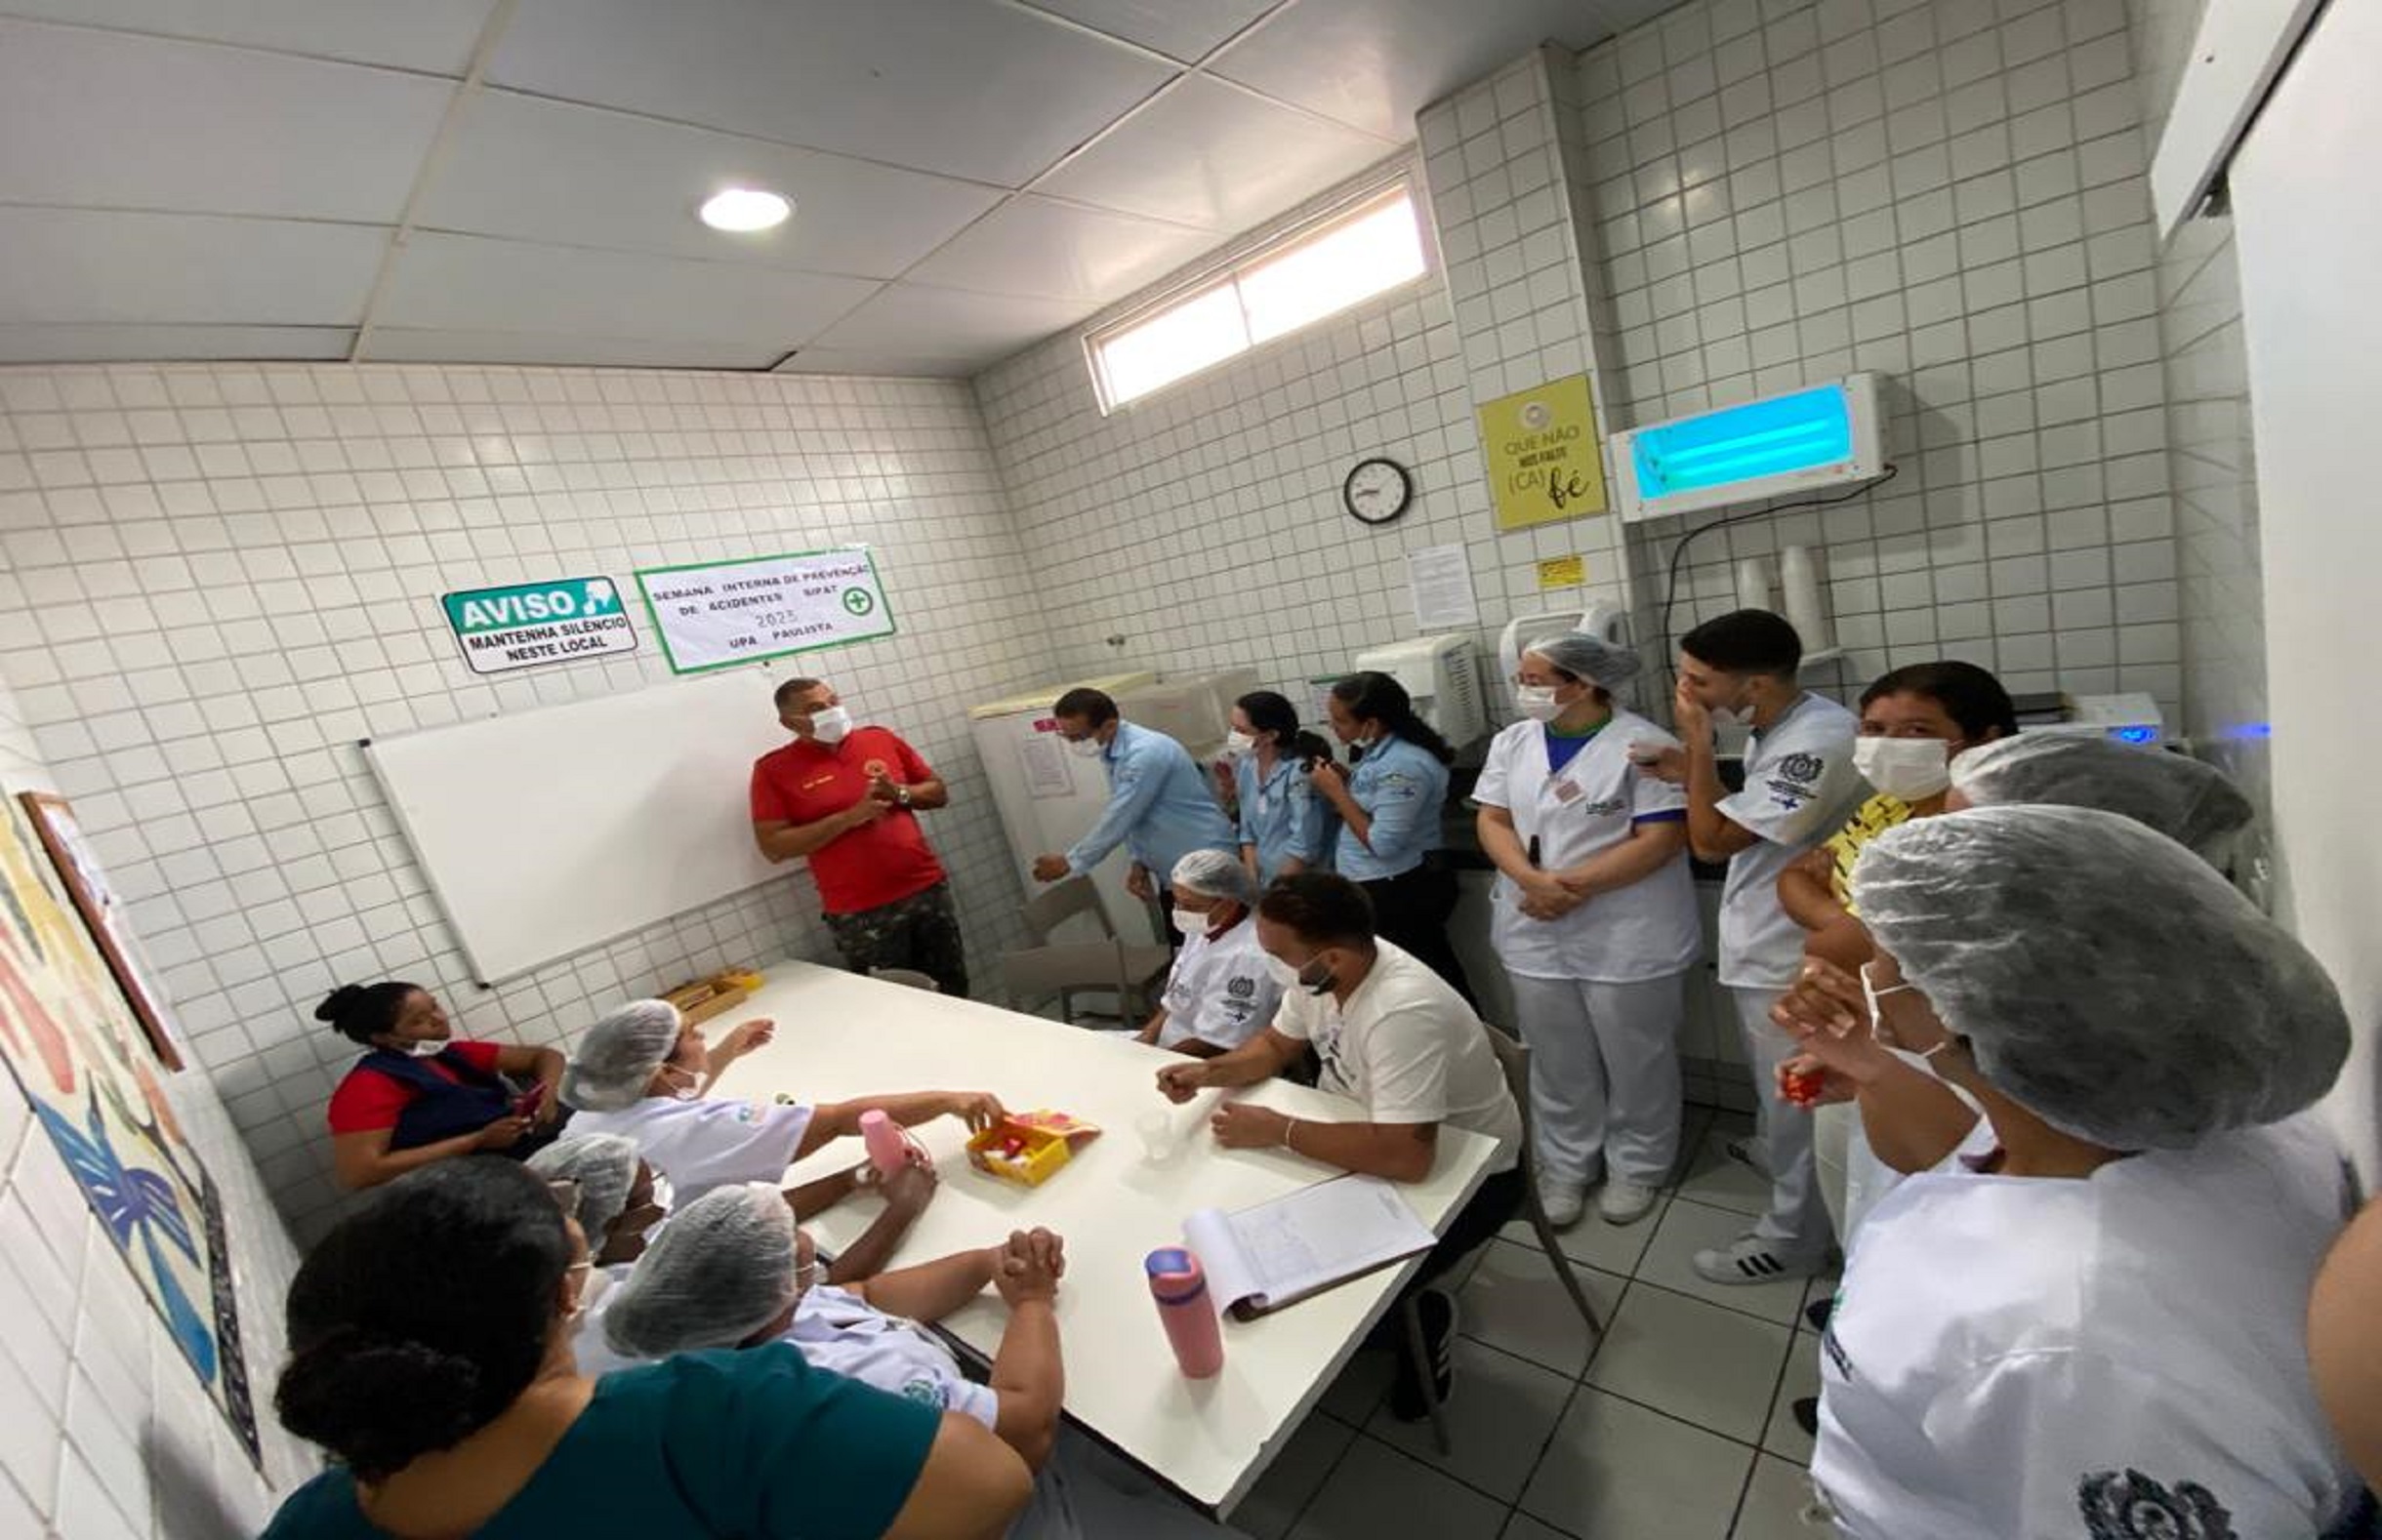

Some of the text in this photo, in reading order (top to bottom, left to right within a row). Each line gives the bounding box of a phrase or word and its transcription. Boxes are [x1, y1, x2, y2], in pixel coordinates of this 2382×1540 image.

[1504, 435, 1539, 456] QUE
[1509, 467, 1544, 497] (CA)
[653, 587, 715, 601] SEMANA
[723, 576, 781, 591] INTERNA
[783, 574, 800, 585] DE
[464, 589, 575, 628] AVISO
[678, 585, 838, 617] DE ACIDENTES SIPAT
[469, 628, 558, 650] MANTENHA
[507, 635, 607, 661] NESTE LOCAL
[729, 623, 833, 649] UPA PAULISTA
